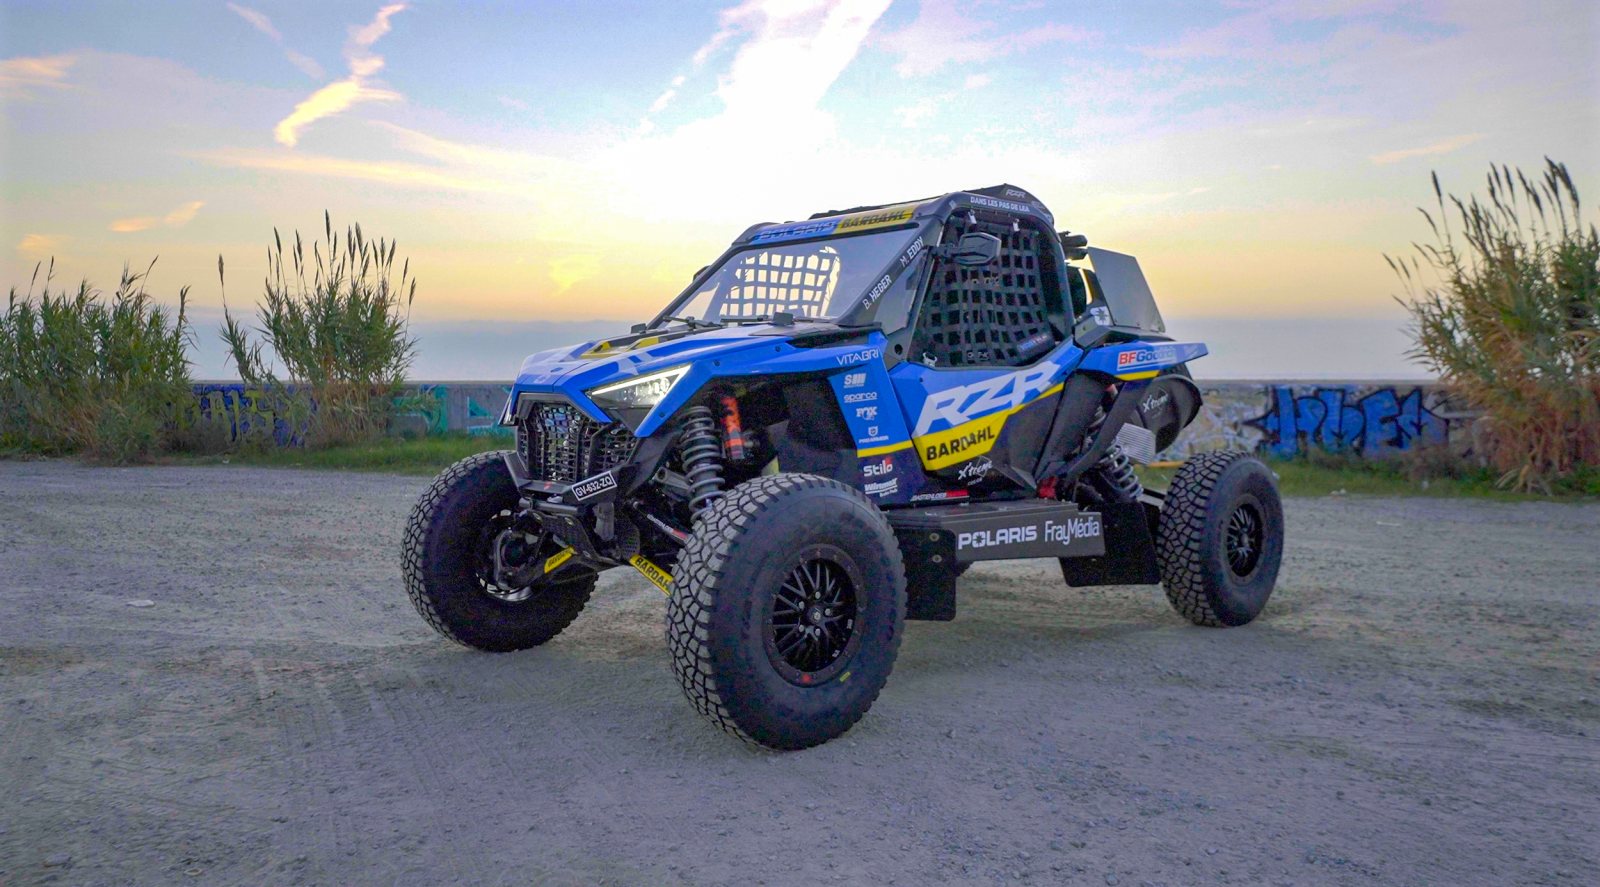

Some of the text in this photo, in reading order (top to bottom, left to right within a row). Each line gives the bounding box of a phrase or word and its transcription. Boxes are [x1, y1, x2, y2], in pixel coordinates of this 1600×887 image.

[970, 196, 987, 206] DANS
[987, 199, 999, 209] LES
[999, 201, 1010, 210] PAS
[1010, 203, 1019, 211] DE
[1019, 205, 1031, 213] LEA
[900, 235, 925, 269] M. EDDY
[862, 273, 893, 311] B. HEGER
[836, 348, 879, 365] VITABRI
[911, 360, 1061, 438] RZR
[926, 425, 996, 461] BARDAHL
[863, 458, 893, 477] Stilo
[574, 476, 615, 497] GV-632-ZQ
[958, 516, 1100, 550] POLARIS FrayMédia
[634, 556, 672, 589] BARDAH
